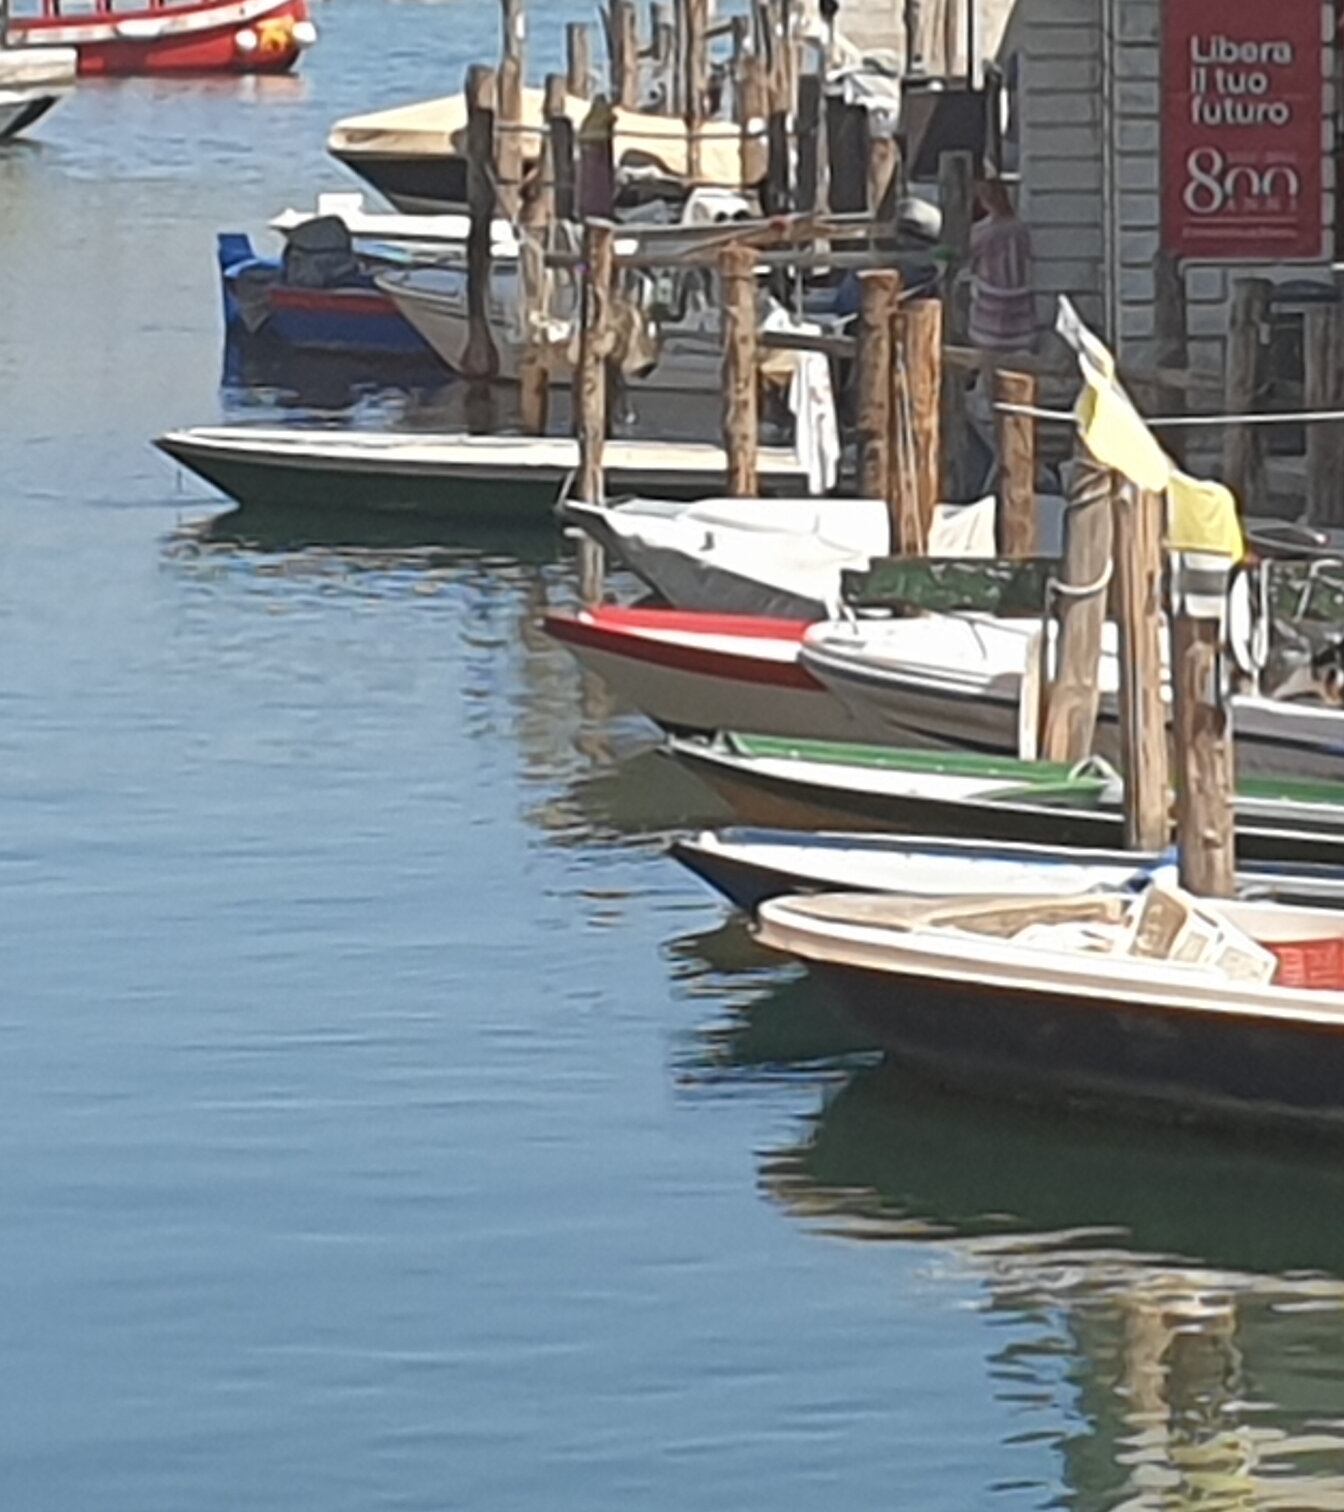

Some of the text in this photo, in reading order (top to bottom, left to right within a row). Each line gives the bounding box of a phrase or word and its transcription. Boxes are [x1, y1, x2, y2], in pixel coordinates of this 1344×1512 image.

[1190, 35, 1292, 64] Libera
[1190, 67, 1268, 95] il tuo
[1190, 95, 1290, 125] futuro
